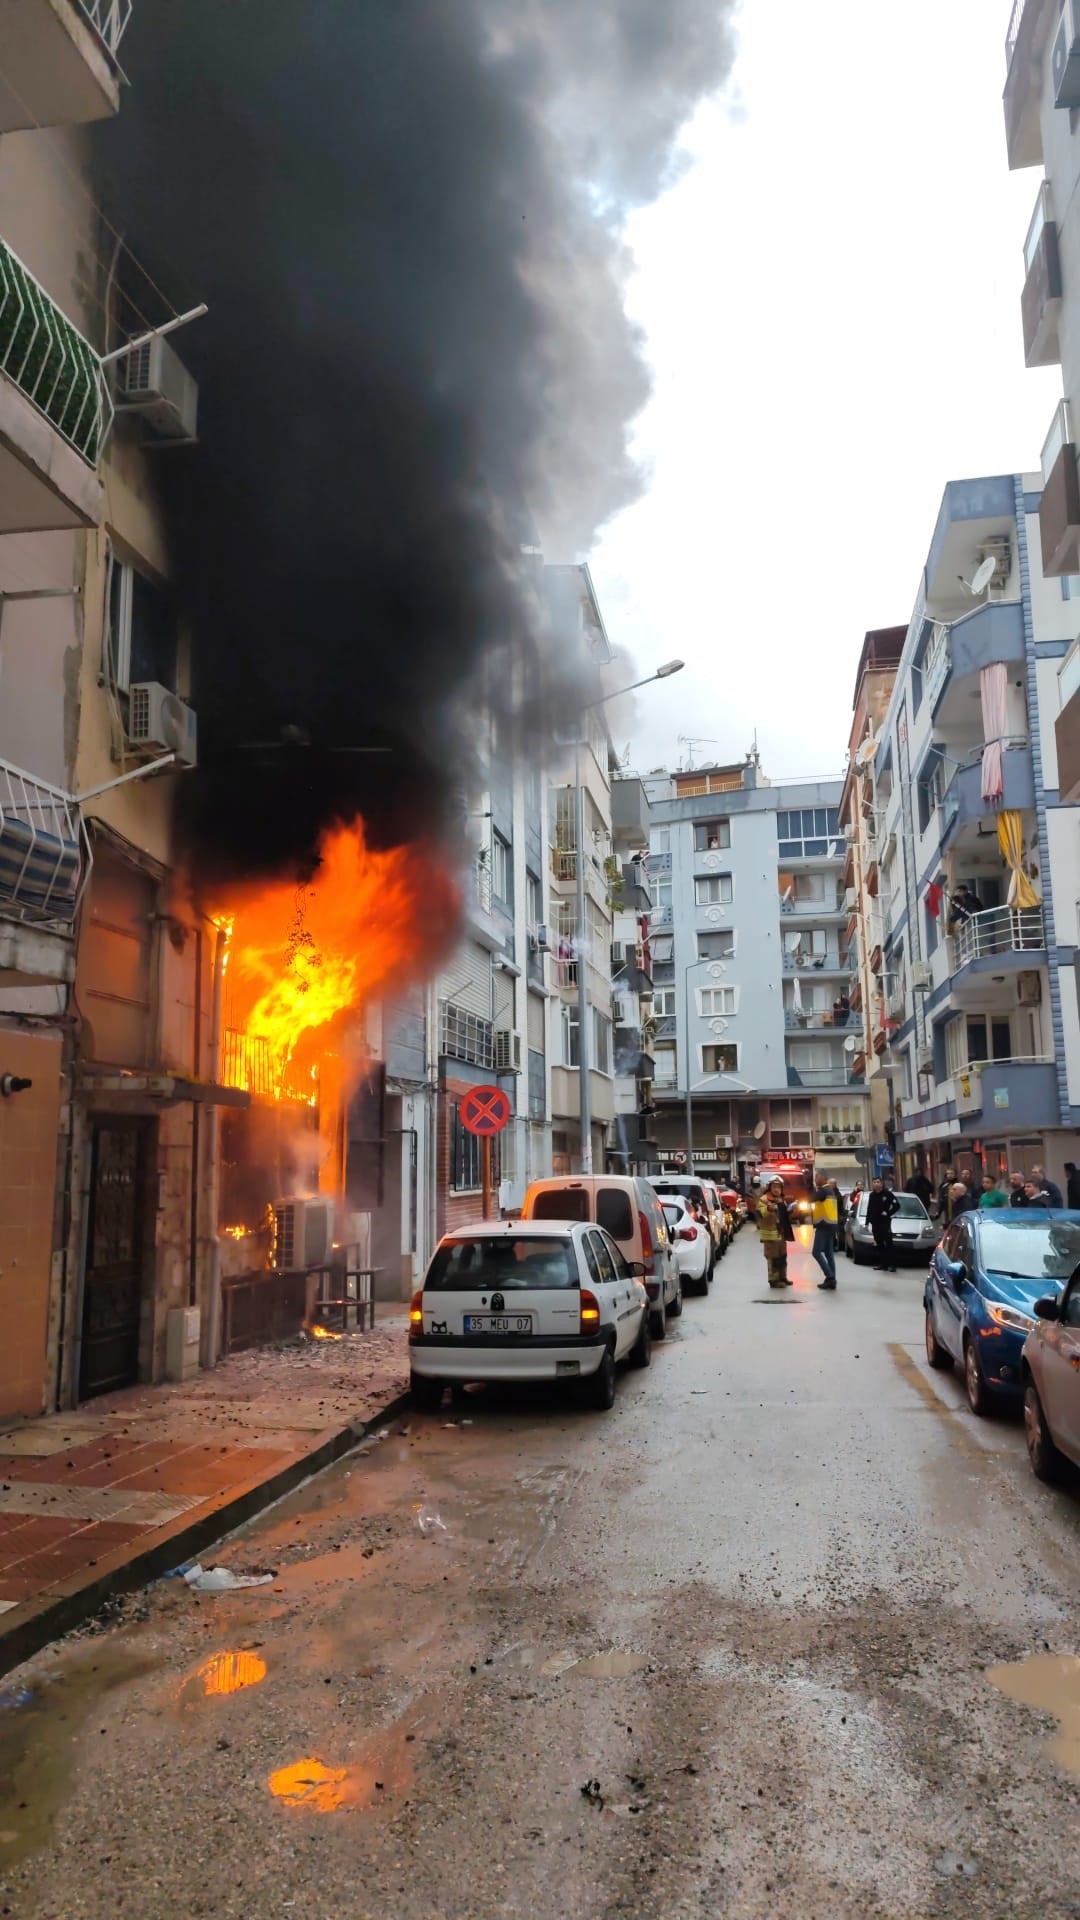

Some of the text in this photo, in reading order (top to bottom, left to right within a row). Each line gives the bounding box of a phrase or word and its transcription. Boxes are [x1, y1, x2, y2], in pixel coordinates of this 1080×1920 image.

[471, 1318, 528, 1329] 35 MEU 07
